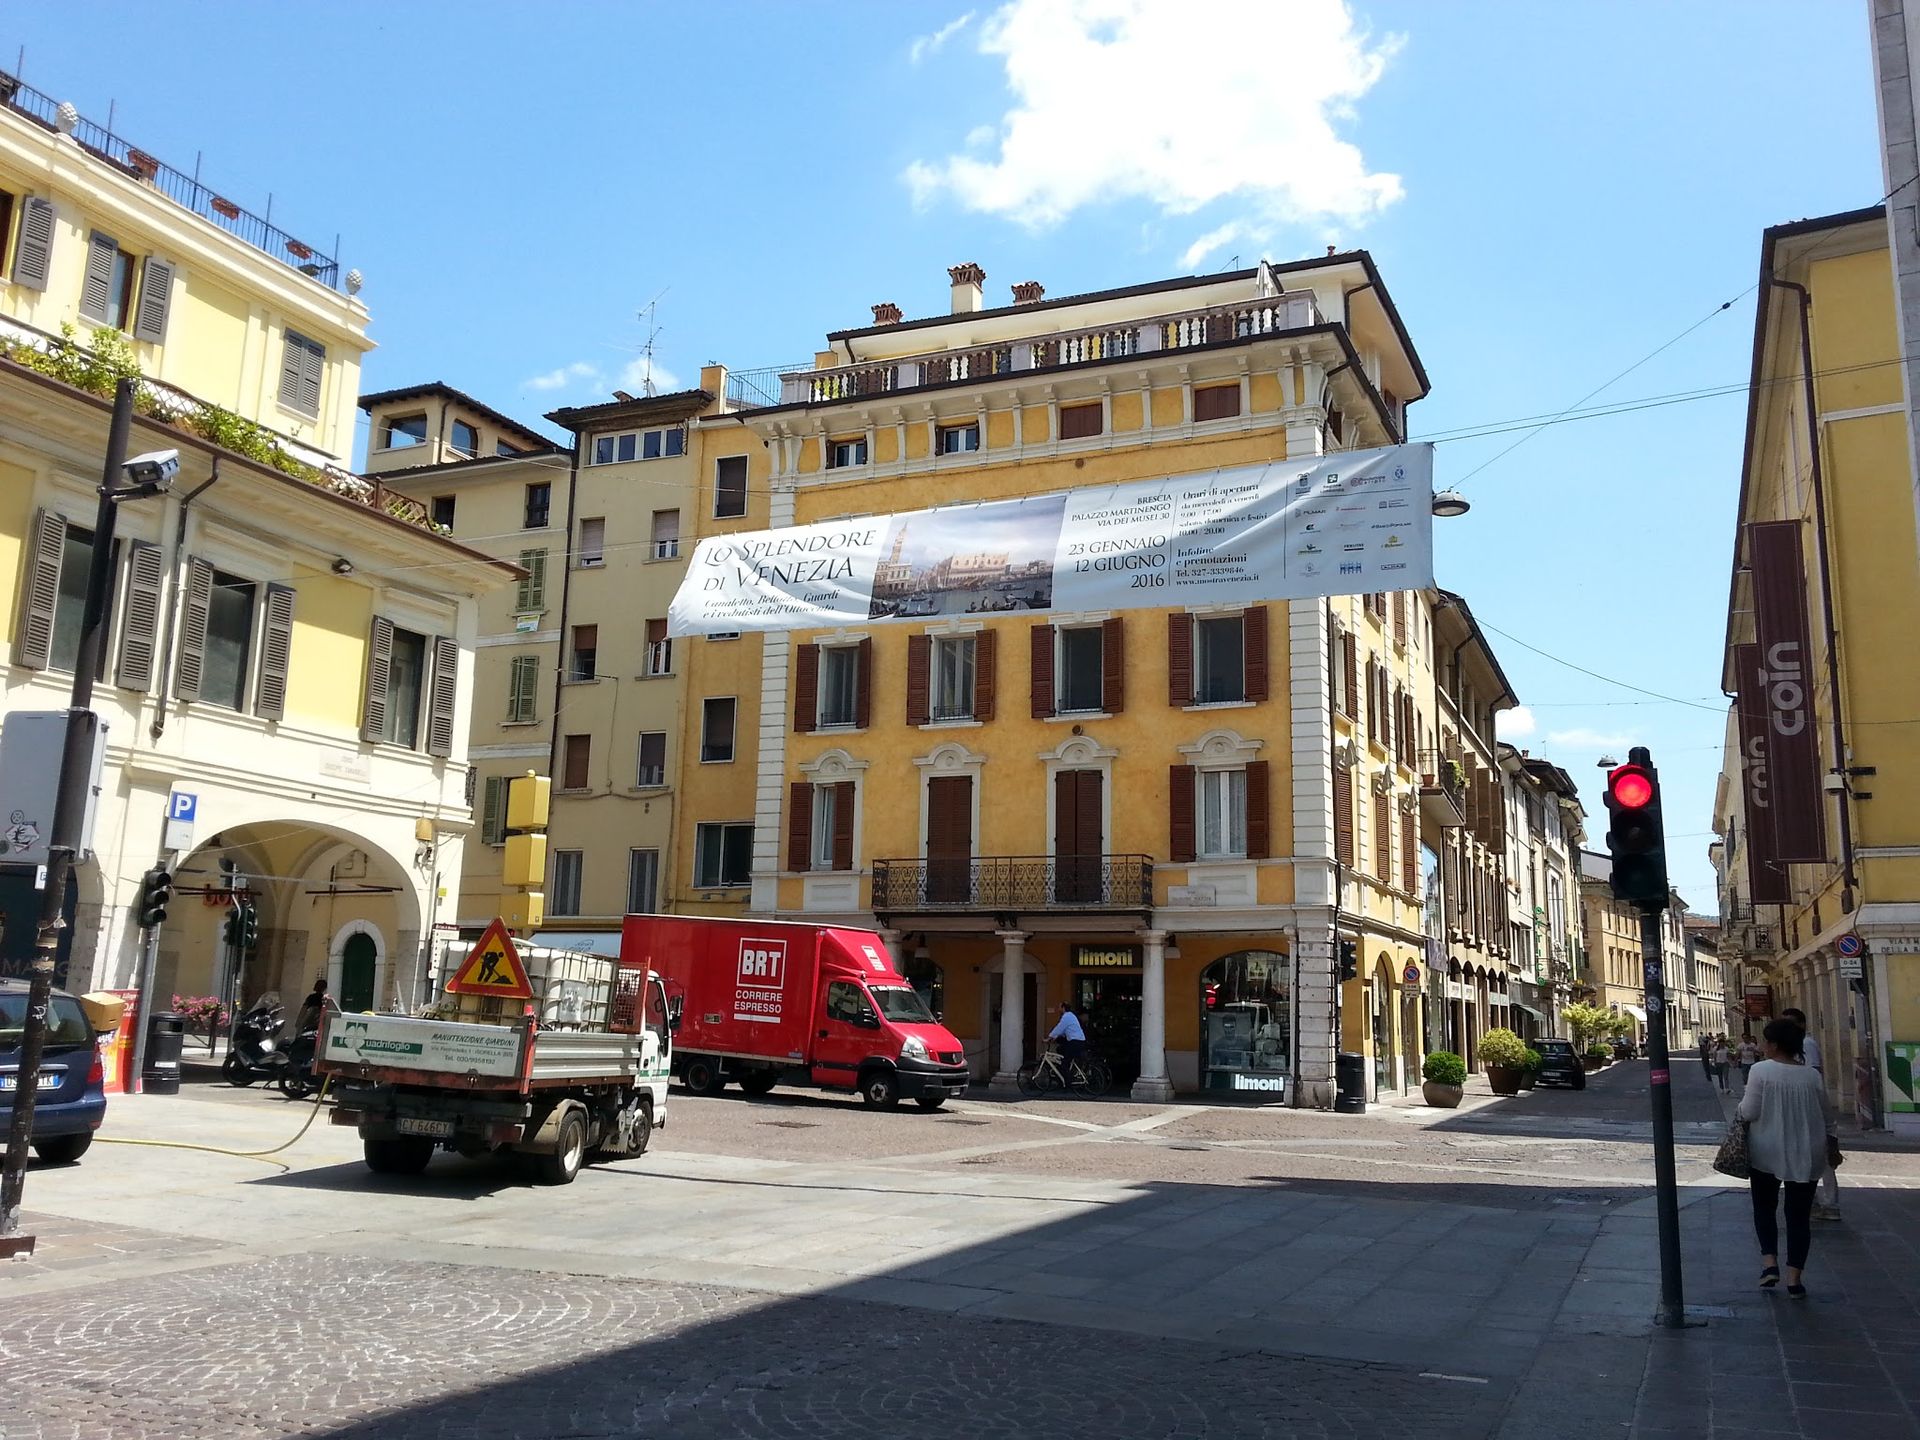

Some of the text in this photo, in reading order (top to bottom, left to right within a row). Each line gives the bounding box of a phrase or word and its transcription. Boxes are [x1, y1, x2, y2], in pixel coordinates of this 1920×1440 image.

[1137, 494, 1172, 505] BRESCIA
[1071, 503, 1171, 522] PALAZZO MARTINENGO
[1113, 517, 1128, 525] DEI
[1130, 513, 1158, 523] MUSEI
[1159, 512, 1170, 520] 30
[704, 530, 877, 567] LO SPLENDORE
[1068, 535, 1166, 556] 23 GENNAIO
[1075, 553, 1166, 573] 12 GIUGNO
[1184, 553, 1247, 568] prenotazioni
[703, 556, 854, 591] DI VENEZIA
[1131, 573, 1165, 588] 2016
[803, 589, 840, 602] Guardi
[1758, 641, 1806, 736] coin
[174, 794, 192, 818] P
[1535, 906, 1546, 987] OTTICO
[742, 949, 782, 977] BRT
[1079, 948, 1133, 966] limoni
[735, 989, 783, 1002] CORRIERE
[734, 1001, 782, 1014] ESPRESSO
[431, 1033, 515, 1047] MANUTENZIONE GIARDINI
[1235, 1074, 1284, 1091] limoni
